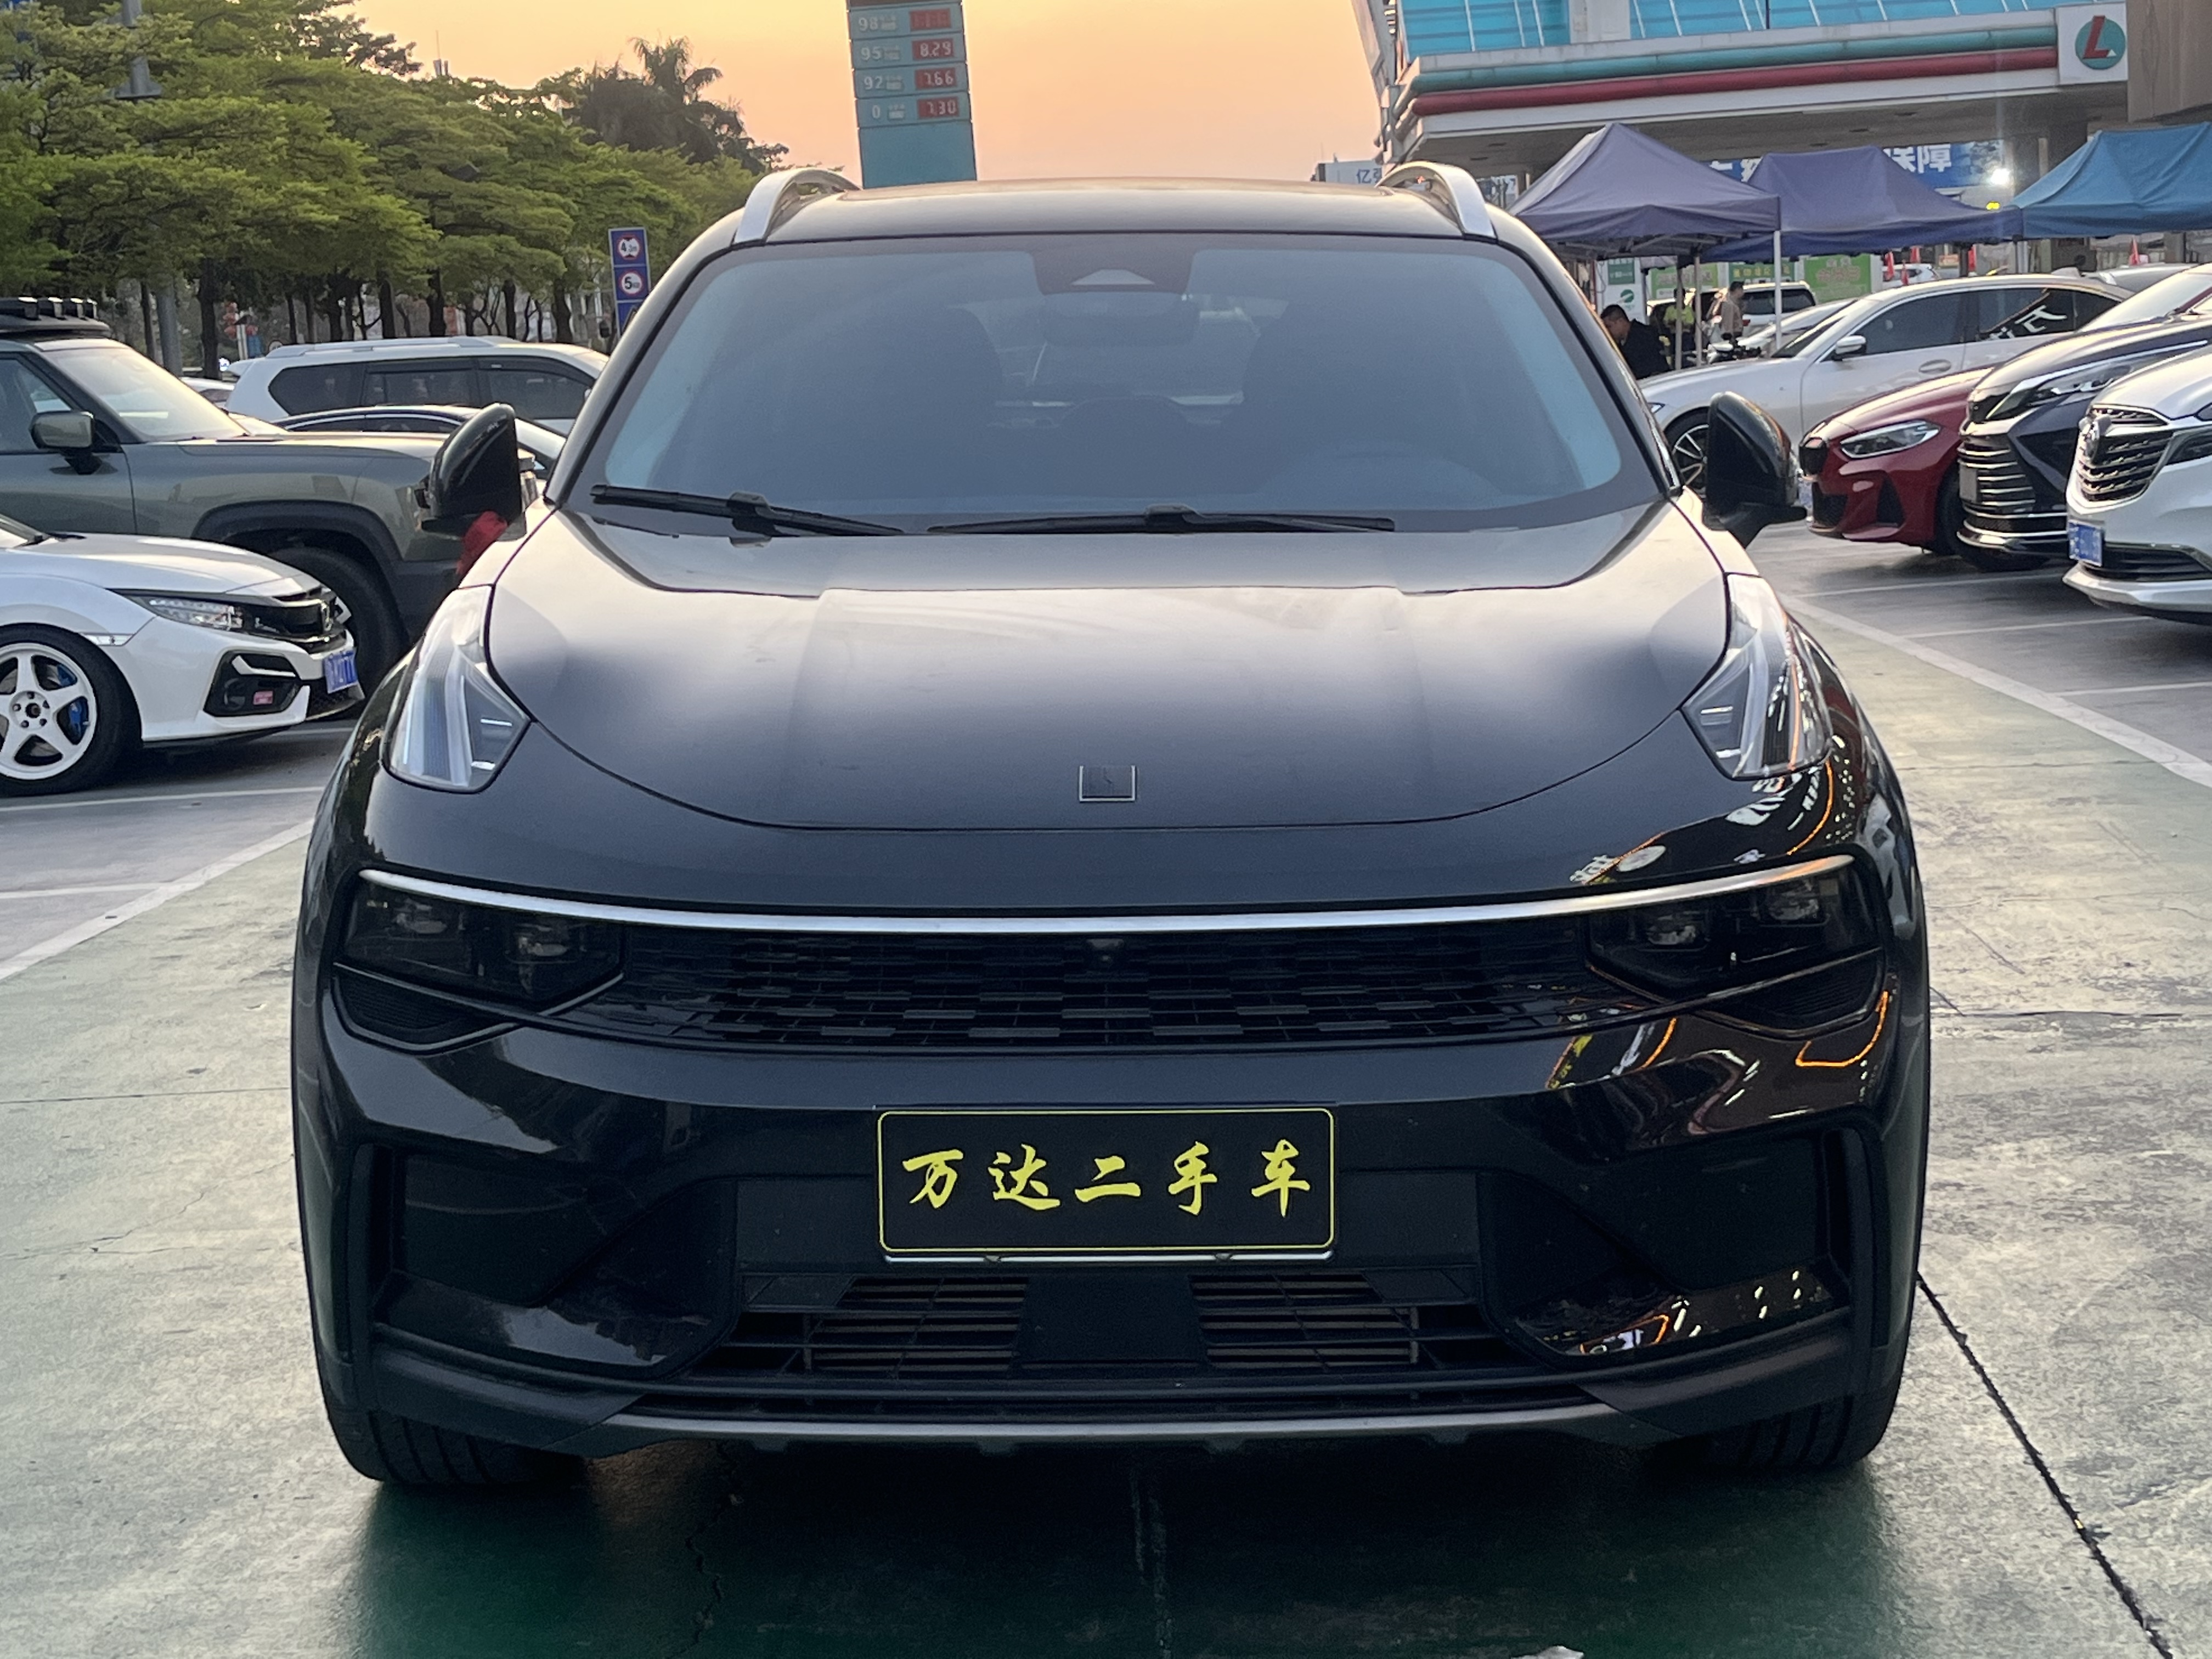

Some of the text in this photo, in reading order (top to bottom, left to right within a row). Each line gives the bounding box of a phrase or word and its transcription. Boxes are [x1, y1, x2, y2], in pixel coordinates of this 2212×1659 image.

[858, 16, 879, 32] 98
[861, 46, 882, 61] 95
[920, 41, 952, 57] 8.29
[864, 76, 883, 90] 92
[872, 105, 881, 119] 0
[902, 1138, 1311, 1217] 万达二手车
